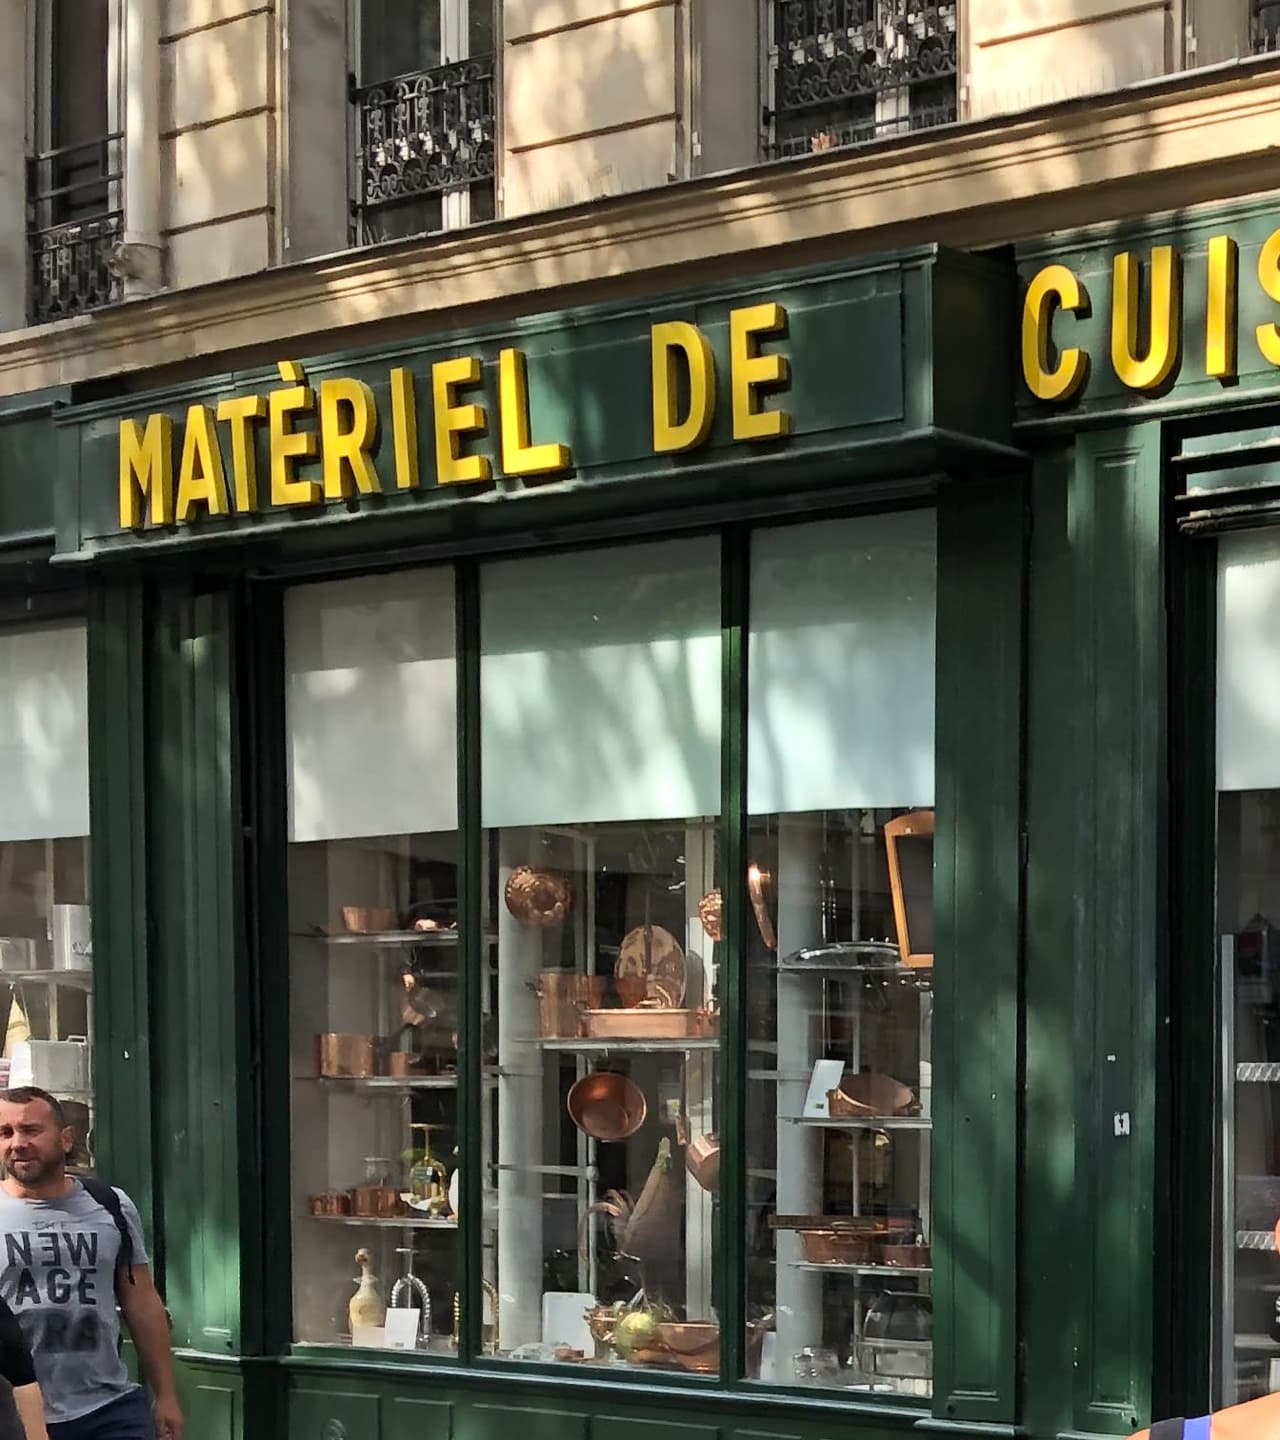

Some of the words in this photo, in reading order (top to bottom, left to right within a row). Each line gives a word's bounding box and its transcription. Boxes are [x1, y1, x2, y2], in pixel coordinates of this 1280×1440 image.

[118, 348, 571, 530] MATÈRIEL
[651, 302, 791, 453] DE
[5, 1231, 98, 1267] NEW
[15, 1268, 97, 1305] AGE
